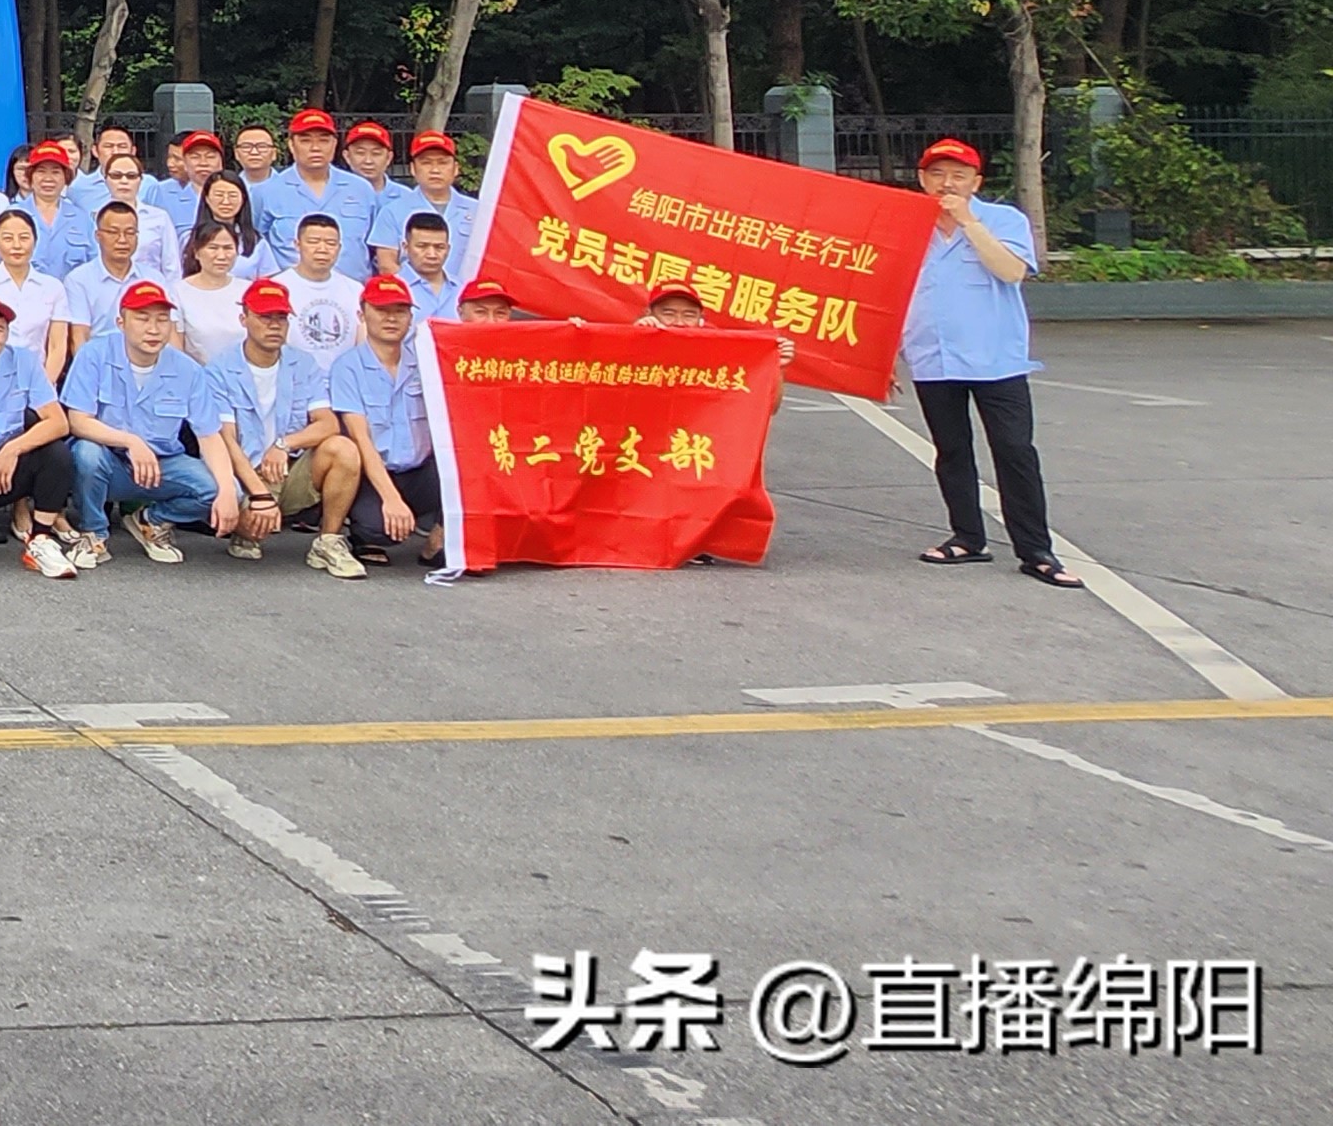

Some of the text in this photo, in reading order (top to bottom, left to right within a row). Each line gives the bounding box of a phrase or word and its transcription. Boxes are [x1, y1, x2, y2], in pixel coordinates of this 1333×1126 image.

[627, 186, 880, 276] 绵阳市出租汽车行业
[531, 215, 860, 347] 党员志愿者服务队
[454, 355, 751, 394] 中共绵阳市交通运输局道路运输管理处总支
[488, 422, 716, 481] 第二党支部
